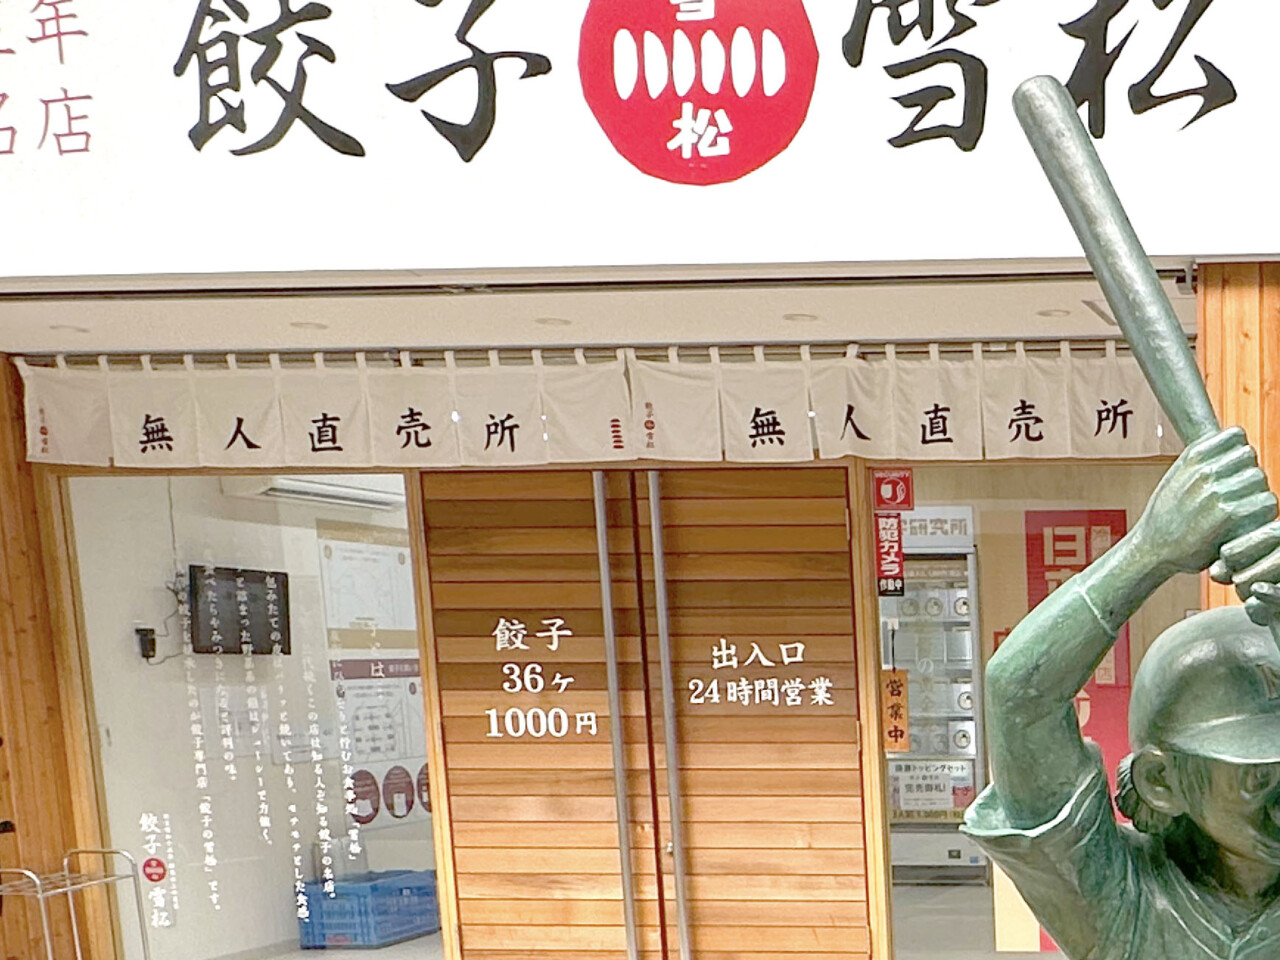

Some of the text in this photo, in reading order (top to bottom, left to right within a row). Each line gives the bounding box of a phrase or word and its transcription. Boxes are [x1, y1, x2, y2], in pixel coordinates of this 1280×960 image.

[0, 0, 89, 65] 年
[174, 0, 553, 163] 餃子
[138, 406, 520, 454] 無人直売所
[748, 399, 1134, 449] 無人直売所
[878, 517, 900, 577] 防犯カメラ
[491, 617, 573, 651] 餃子
[711, 638, 806, 671] 出入口
[688, 677, 835, 707] 24時間営業
[884, 678, 906, 744] 営業中
[485, 707, 598, 738] 1000円
[138, 812, 163, 856] 餃子
[148, 886, 172, 929] 雪松
